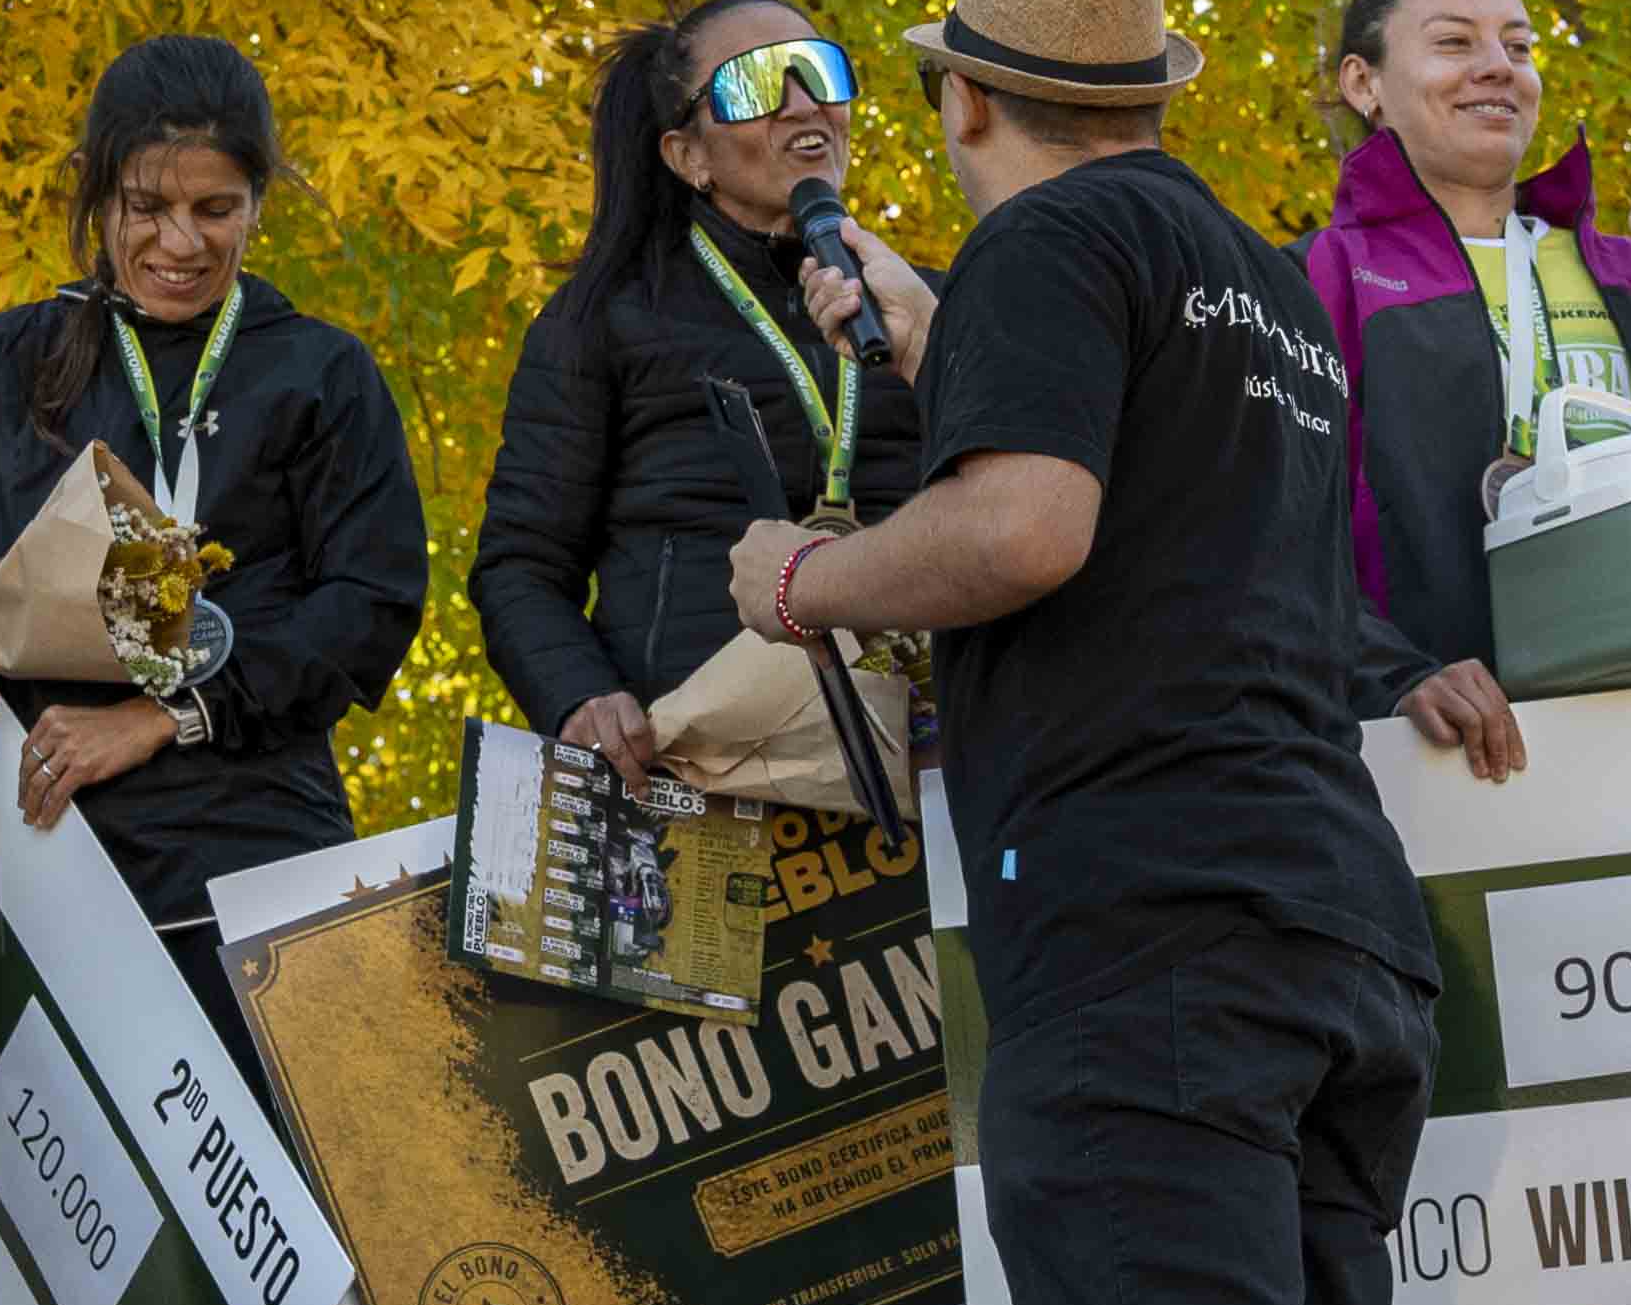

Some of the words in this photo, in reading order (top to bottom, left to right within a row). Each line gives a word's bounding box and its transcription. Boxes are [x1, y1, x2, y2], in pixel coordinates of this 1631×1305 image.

[528, 1015, 772, 1186] BONO
[5, 1085, 118, 1272] 120.000
[730, 1178, 772, 1208] ESTE
[776, 1159, 823, 1188] BONO
[828, 1124, 915, 1169] CERTIFICA
[772, 1197, 798, 1218] HA
[801, 1166, 883, 1208] OBTENIDO
[887, 1157, 907, 1175] EL
[434, 1280, 459, 1304] EL
[459, 1256, 518, 1280] BONO
